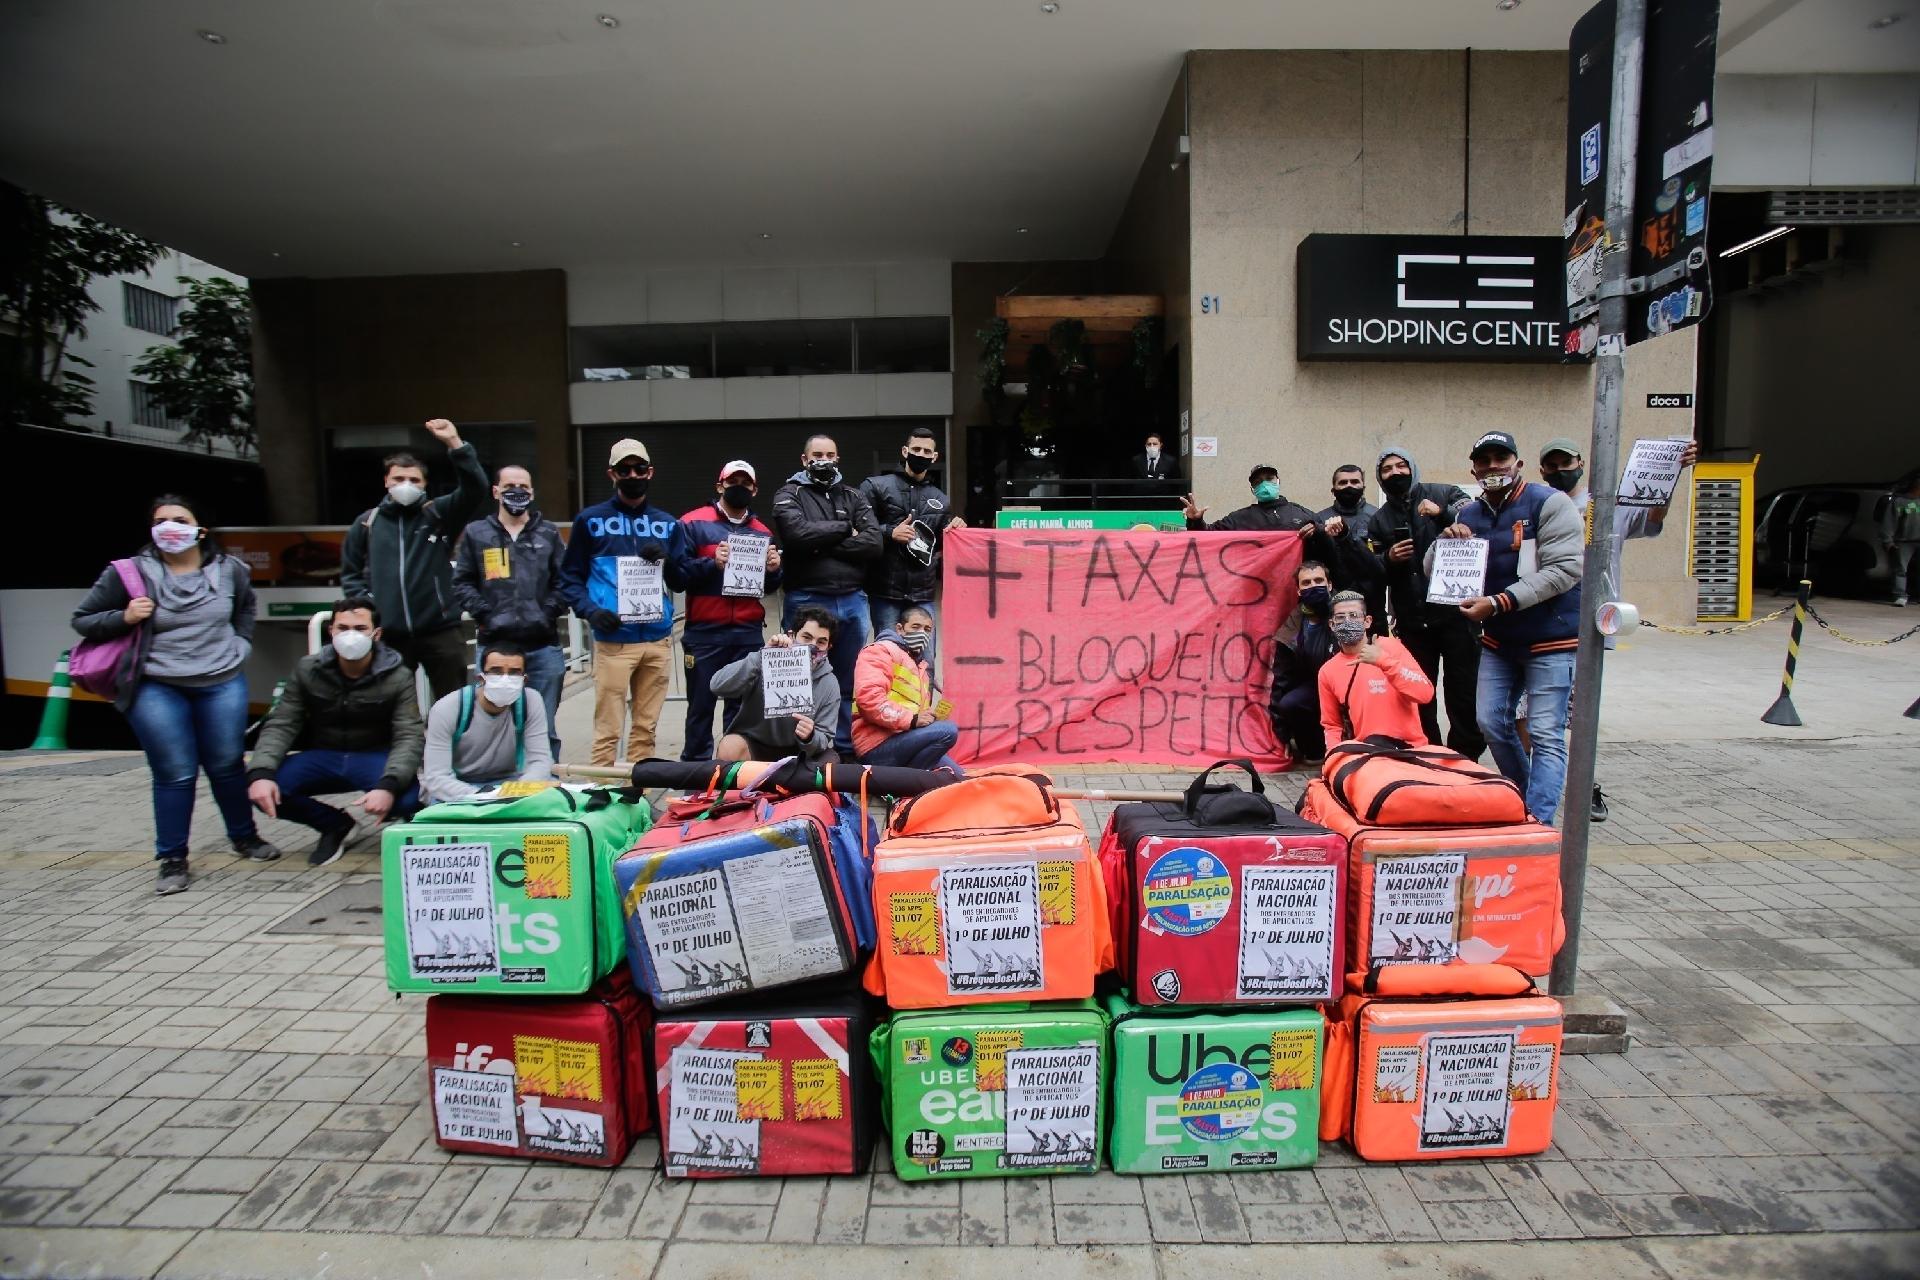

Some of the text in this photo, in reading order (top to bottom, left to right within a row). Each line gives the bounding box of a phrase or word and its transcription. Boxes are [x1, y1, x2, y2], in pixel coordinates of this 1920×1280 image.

[1201, 295, 1220, 314] 91
[1328, 319, 1560, 346] SHOPPING CENTE
[1650, 396, 1690, 407] doca 1
[1636, 452, 1677, 461] NACIONAL
[1651, 473, 1675, 481] JULHO
[1011, 518, 1027, 529] CAFÉ
[1029, 520, 1037, 529] DA
[1068, 519, 1093, 529] ALMOÇO
[1023, 535, 1268, 613] TAXAS
[768, 659, 803, 668] NACIONAL
[776, 680, 785, 688] DE
[787, 679, 808, 687] JULHO
[1010, 684, 1277, 756] RESPEITO
[410, 852, 481, 870] PARALISAÇÃO
[528, 855, 555, 865] 01/07
[1380, 859, 1458, 878] PARALISAÇÃO
[417, 871, 477, 886] NACIONAL
[950, 872, 1027, 891] PARALISAÇÃO
[1251, 876, 1326, 896] PARALISAÇÃO
[1386, 877, 1449, 890] NACIONAL
[639, 875, 717, 904] PARALISAÇÃO
[1149, 884, 1230, 901] PARALISAÇÃO
[958, 891, 1022, 906] NACIONAL
[1257, 894, 1318, 907] NACIONAL
[414, 907, 484, 922] 1º DE JULHO
[650, 894, 717, 920] NACIONAL
[895, 913, 922, 923] 01/07
[1379, 911, 1454, 925] 1º DE JULHO
[497, 903, 561, 954] ts
[955, 926, 1030, 942] 1º DE JULHO
[654, 930, 732, 957] 1º DE JULHO
[1251, 930, 1324, 944] 1º DE JULHO
[1276, 1051, 1303, 1060] 01/07
[1435, 1040, 1507, 1057] PARALISAÇÃO
[519, 1055, 544, 1064] 01/07
[561, 1060, 586, 1070] 01/07
[1012, 1052, 1091, 1071] PARALISAÇÃO
[1148, 1033, 1271, 1085] Ube
[1439, 1056, 1499, 1071] NACIONAL
[1380, 1065, 1406, 1074] 01/07
[1514, 1063, 1540, 1071] 01/07
[921, 1068, 976, 1085] UBE
[1018, 1071, 1085, 1087] NACIONAL
[439, 1075, 508, 1094] PARALISAÇÃO
[739, 1081, 767, 1089] 01/07
[797, 1080, 825, 1089] 01/07
[444, 1094, 503, 1109] NACIONAL
[1194, 1091, 1202, 1100] DE
[1432, 1089, 1503, 1103] 1º DE JULHO
[1183, 1096, 1260, 1111] PARALISAÇÃO
[676, 1107, 709, 1121] 1º DE
[1013, 1105, 1090, 1121] 1º DE JULHO
[444, 1124, 512, 1141] 1º DE JULHO
[912, 1131, 938, 1144] ELE
[912, 1141, 937, 1154] NÃO
[957, 1137, 1004, 1148] #ENTREG
